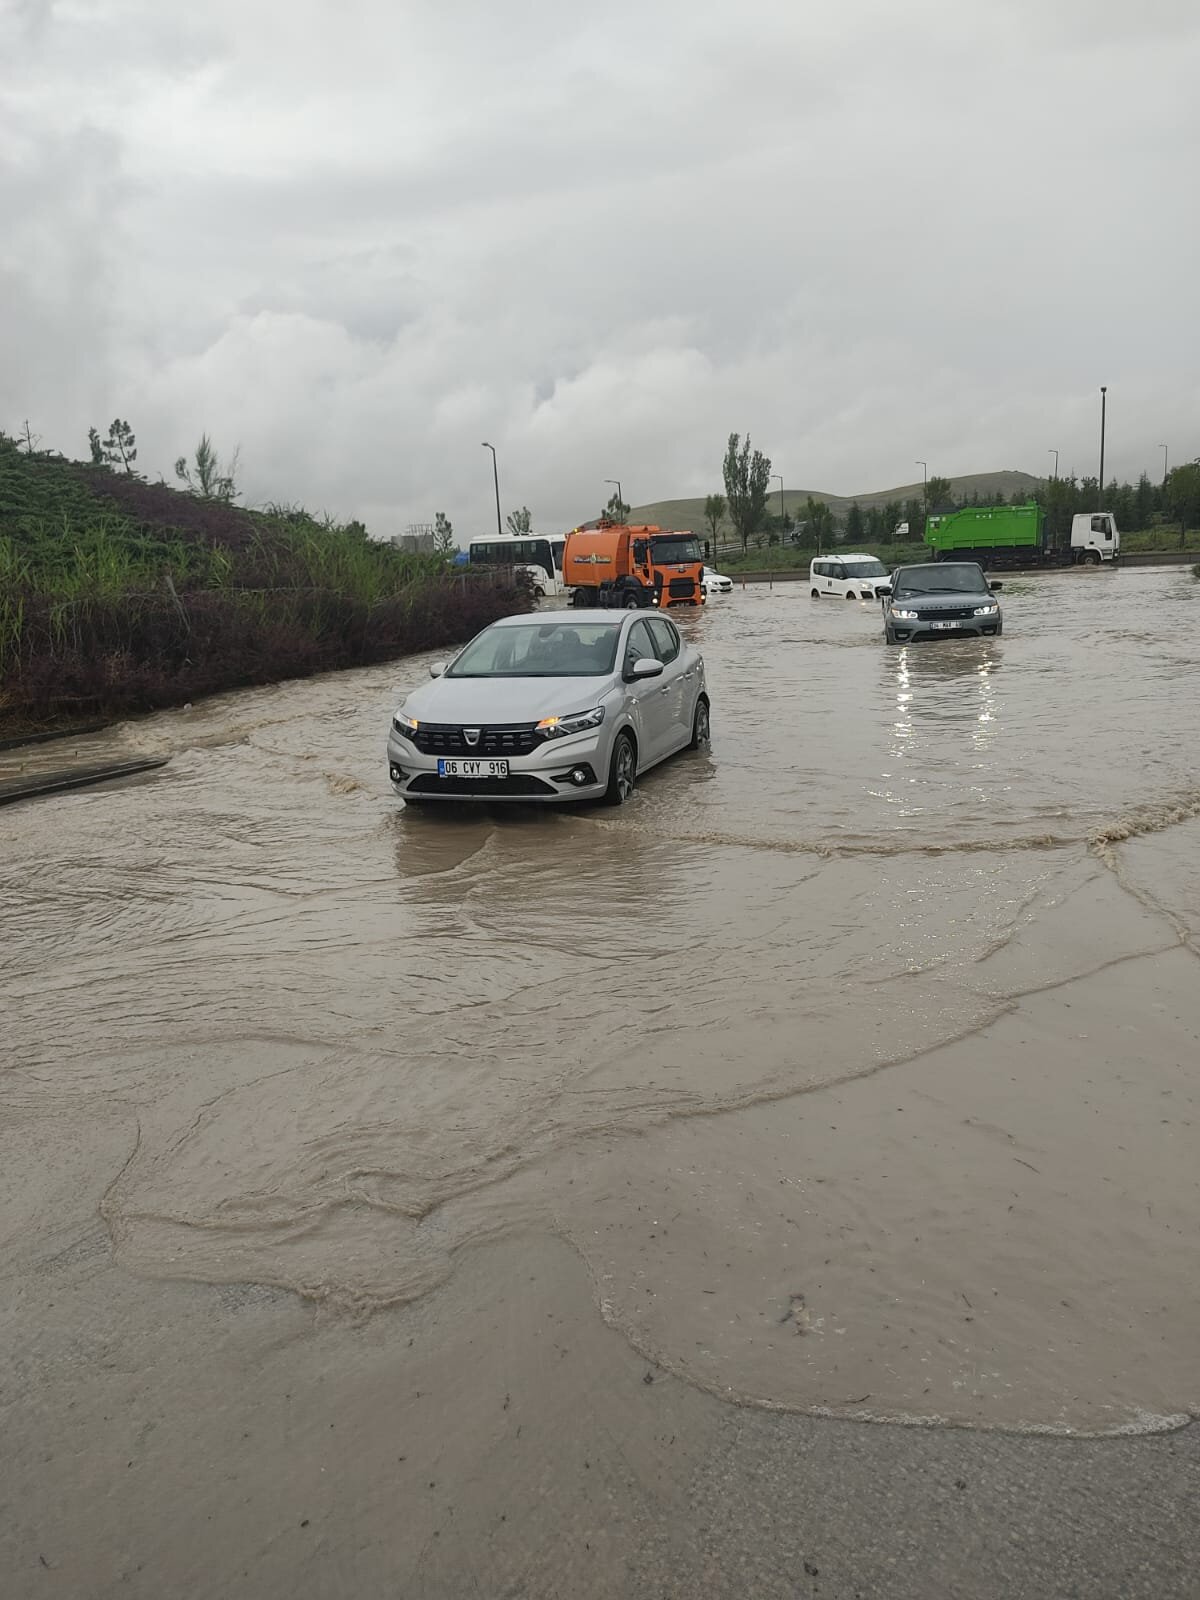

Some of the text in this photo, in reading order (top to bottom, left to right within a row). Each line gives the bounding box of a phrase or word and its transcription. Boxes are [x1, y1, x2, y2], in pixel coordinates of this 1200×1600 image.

[445, 762, 506, 774] 06 CVY 916
